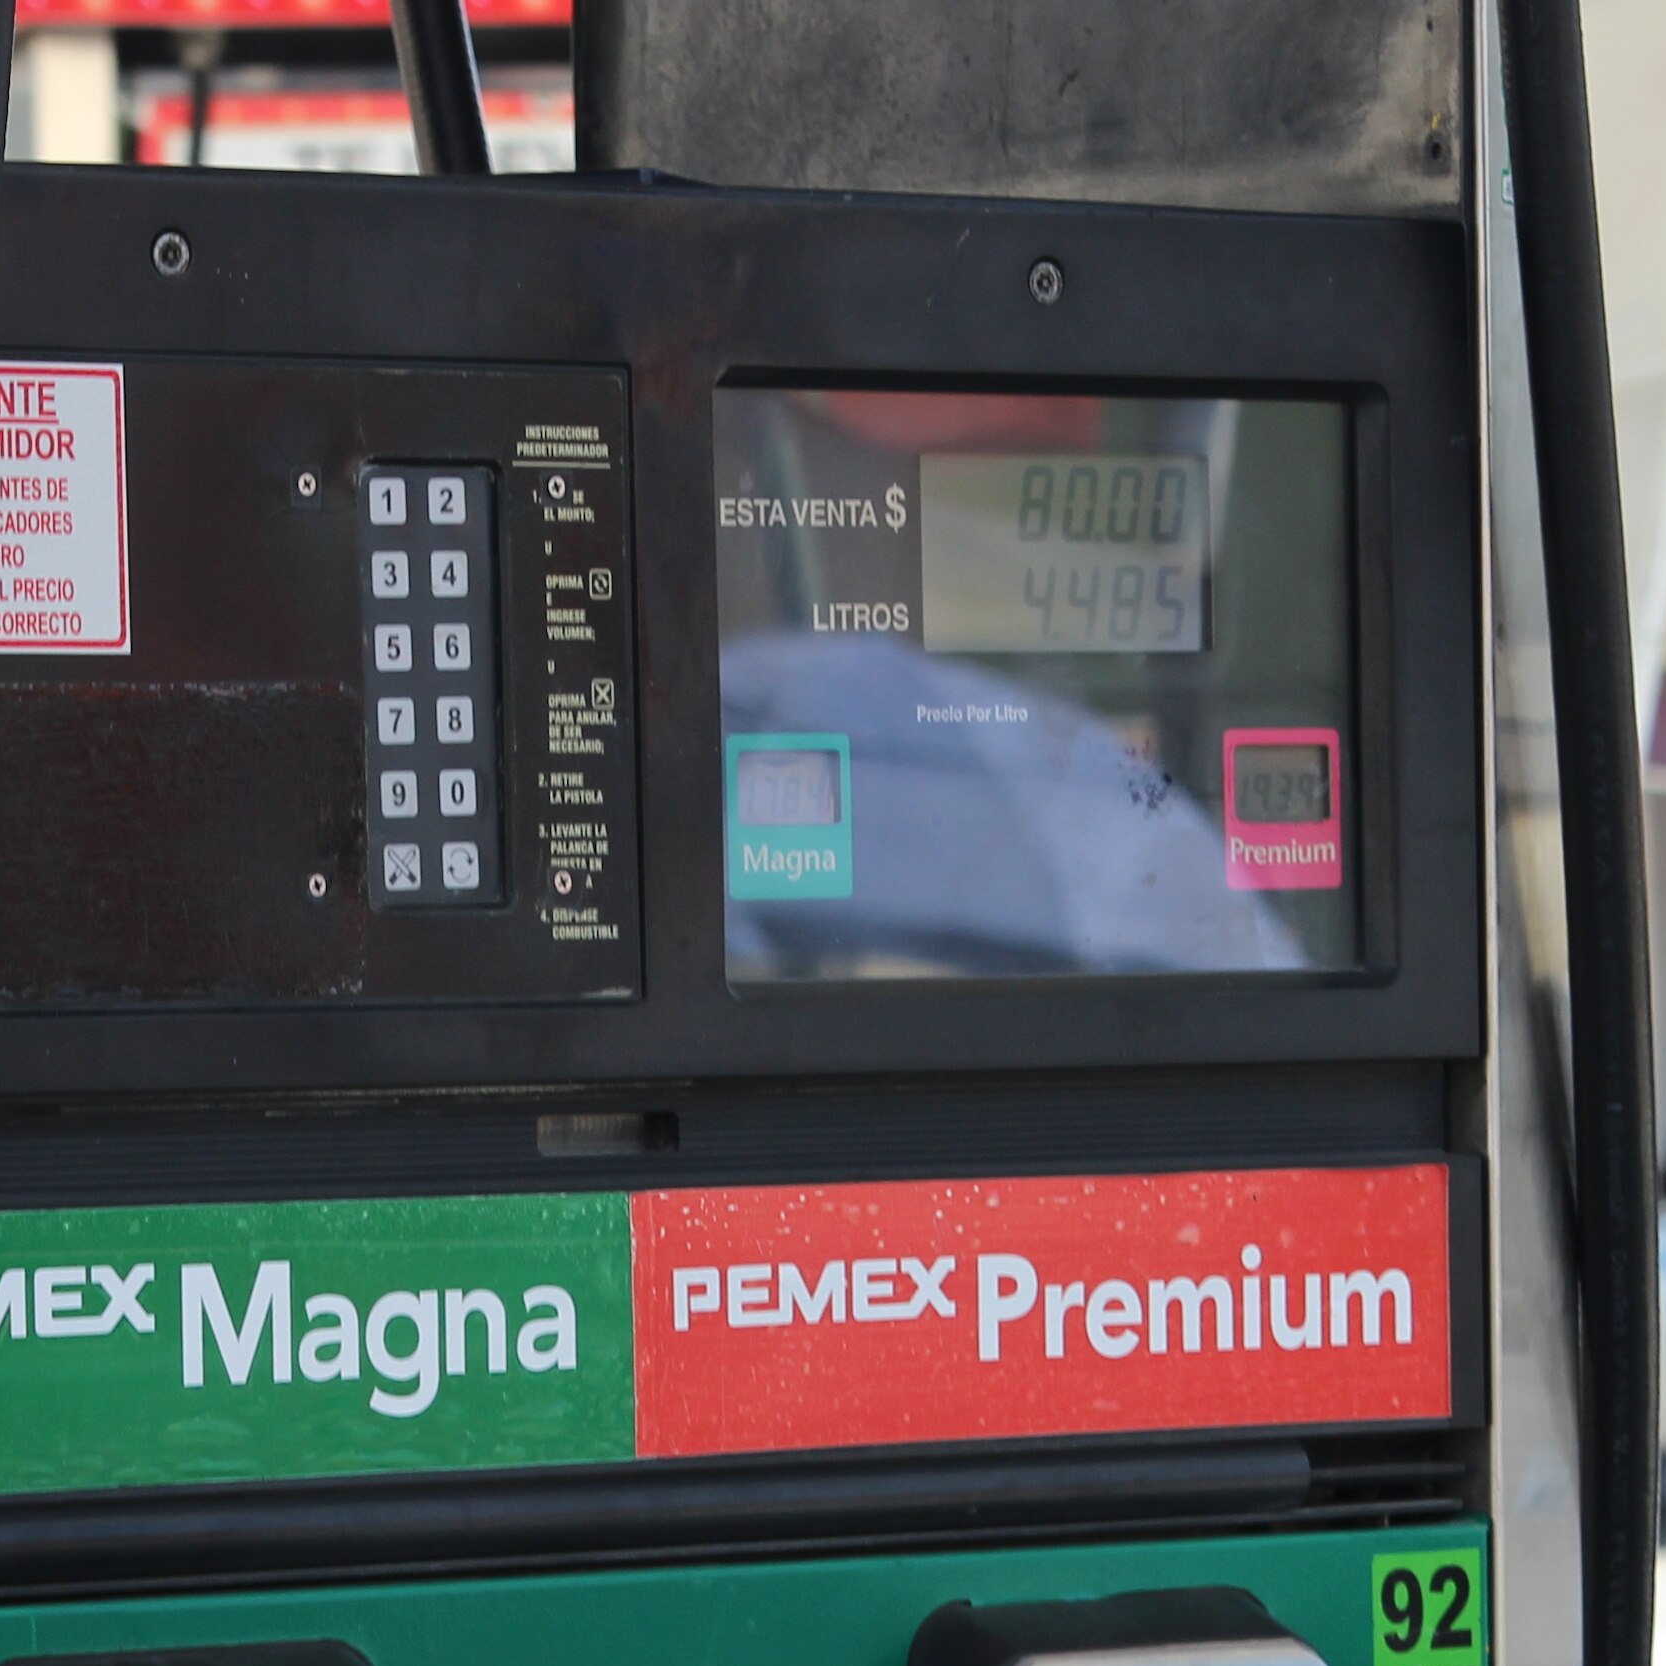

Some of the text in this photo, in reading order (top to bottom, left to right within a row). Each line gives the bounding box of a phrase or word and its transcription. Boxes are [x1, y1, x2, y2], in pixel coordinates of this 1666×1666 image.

[525, 425, 600, 441] INSTRUCCIONES
[516, 441, 609, 458] PREDETERMINADOR
[47, 478, 69, 500] DE
[382, 488, 454, 515] 1 2
[719, 483, 907, 533] ESTA VENTA $
[543, 506, 555, 522] EL
[383, 561, 457, 588] 3 4
[545, 574, 584, 590] OPRIMA
[13, 577, 75, 601] PRECIO
[546, 608, 586, 624] INGRESE
[812, 602, 910, 632] LITROS
[387, 634, 460, 661] 5 6
[548, 693, 586, 708] OPRIMA
[388, 706, 462, 735] 7 8
[548, 710, 575, 725] PARA
[916, 704, 1029, 724] Precio Por Litro
[550, 772, 584, 787] RETIRE
[392, 780, 464, 807] 9 0
[549, 790, 604, 805] LA PISTOLA
[550, 823, 592, 839] LEVANTE
[594, 823, 608, 838] LA
[550, 840, 609, 855] PALANCA DE
[1229, 836, 1337, 866] Premium
[741, 844, 836, 879] Magna
[552, 924, 619, 940] COMBUSTIBLE
[672, 1243, 1413, 1362] PEMEX Premium
[180, 1260, 577, 1418] Magna
[1379, 1563, 1473, 1654] 92
